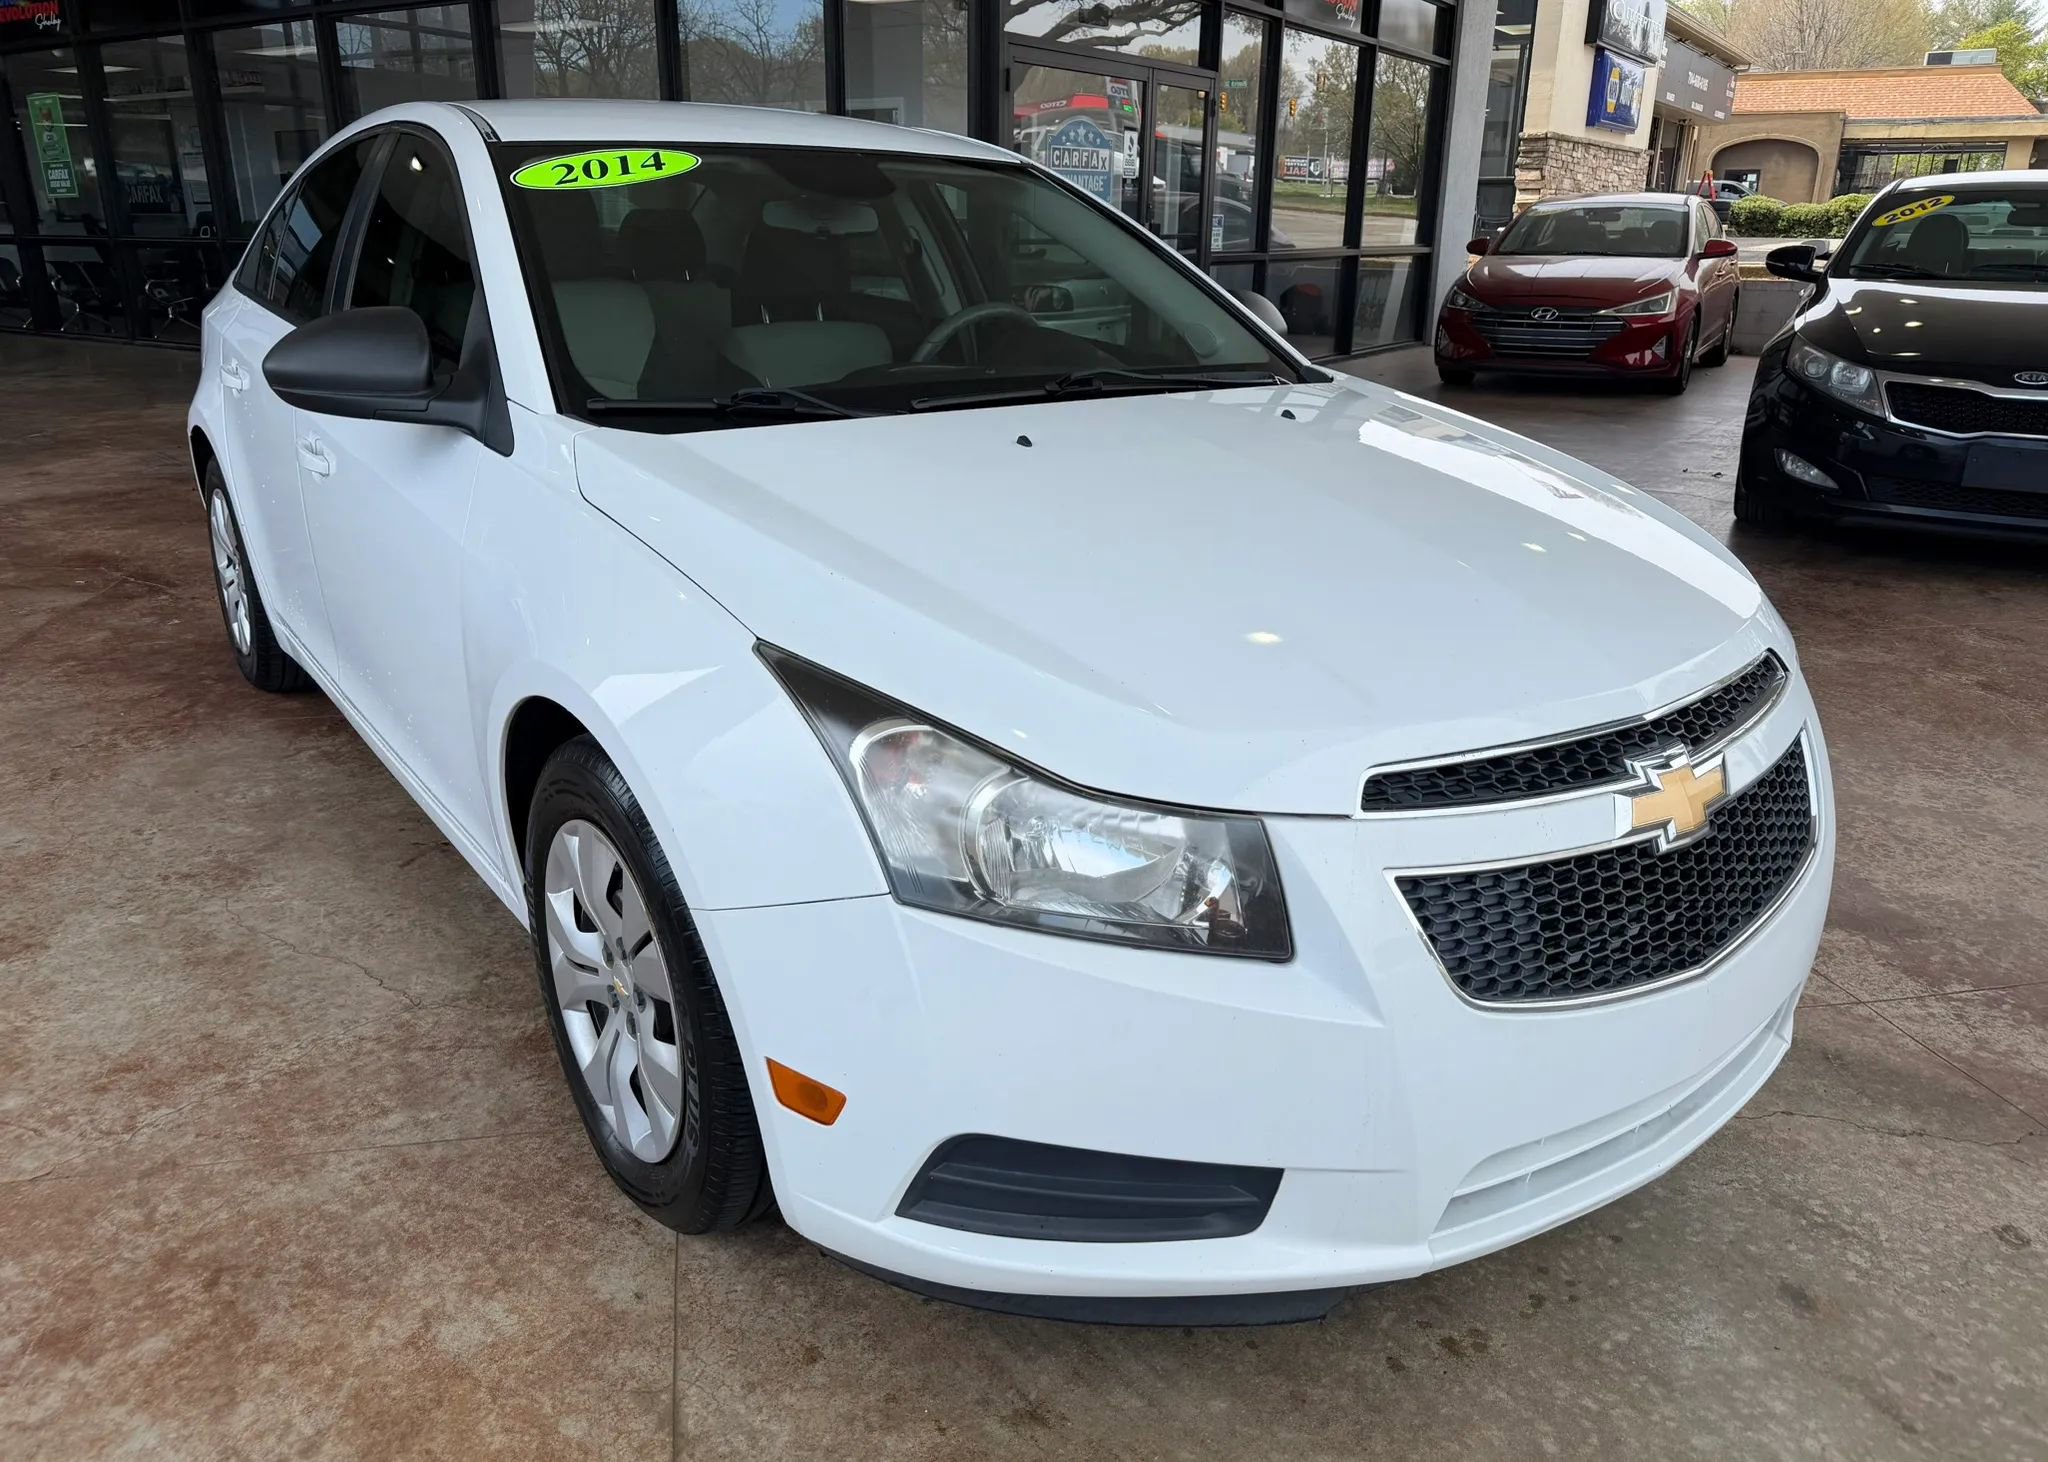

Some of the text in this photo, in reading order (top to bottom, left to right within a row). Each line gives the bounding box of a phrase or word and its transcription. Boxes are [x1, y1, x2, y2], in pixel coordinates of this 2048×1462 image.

[551, 151, 666, 185] 2014
[1053, 149, 1109, 170] CARFAX
[1884, 198, 1945, 223] 2012
